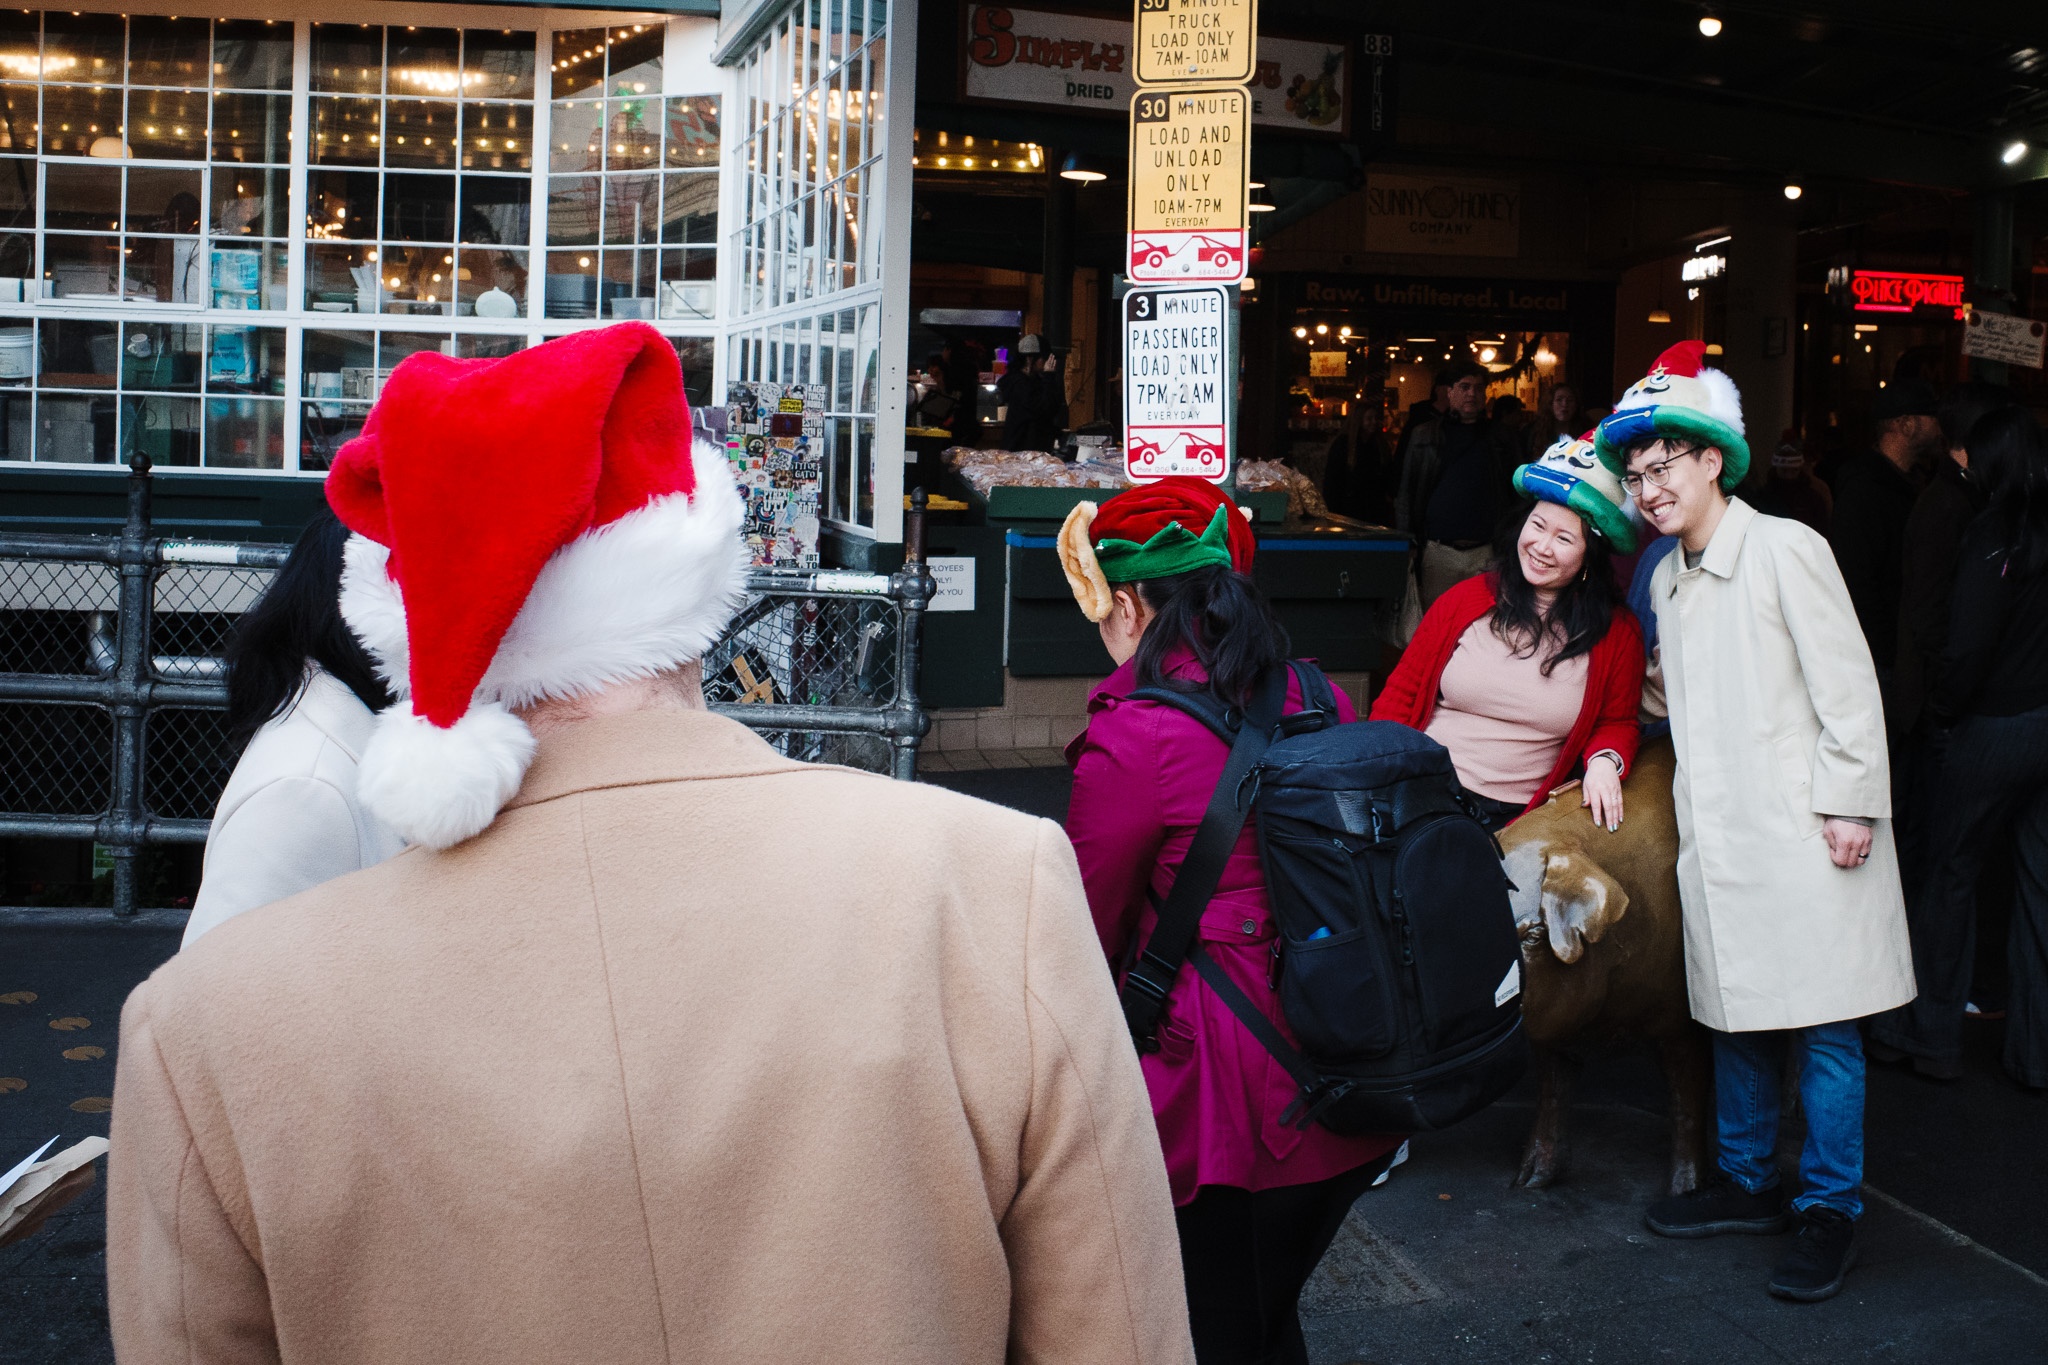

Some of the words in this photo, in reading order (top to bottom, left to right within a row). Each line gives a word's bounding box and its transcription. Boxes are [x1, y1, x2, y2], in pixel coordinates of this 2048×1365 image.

[1169, 13, 1221, 29] TRUCK
[1152, 32, 1189, 48] LOAD
[1197, 30, 1234, 46] ONLY
[1366, 35, 1391, 54] 88
[1066, 82, 1114, 100] DRIED
[1141, 99, 1166, 118] 30
[1178, 98, 1238, 115] MINUTE
[1150, 126, 1190, 146] LOAD
[1199, 125, 1231, 143] AND
[1155, 149, 1222, 167] UNLOAD
[1167, 174, 1210, 192] ONLY
[1154, 198, 1222, 214] 10AM-7PM
[1368, 187, 1427, 217] SUNNY
[1460, 191, 1518, 222] HONEY
[1165, 217, 1210, 227] EVERYDAY
[1409, 221, 1473, 235] COMPANY
[1305, 280, 1365, 303] Raw.
[1375, 282, 1499, 308] Unfiltered.
[1508, 287, 1568, 311] Local
[1136, 295, 1150, 317] 3
[1164, 297, 1217, 314] MINUTE
[1132, 326, 1218, 350] PASSENGER
[1132, 355, 1170, 376] LOAD
[1180, 353, 1218, 375] ONLY
[1147, 410, 1201, 420] EVERYDAY
[930, 564, 964, 572] PLOYEES
